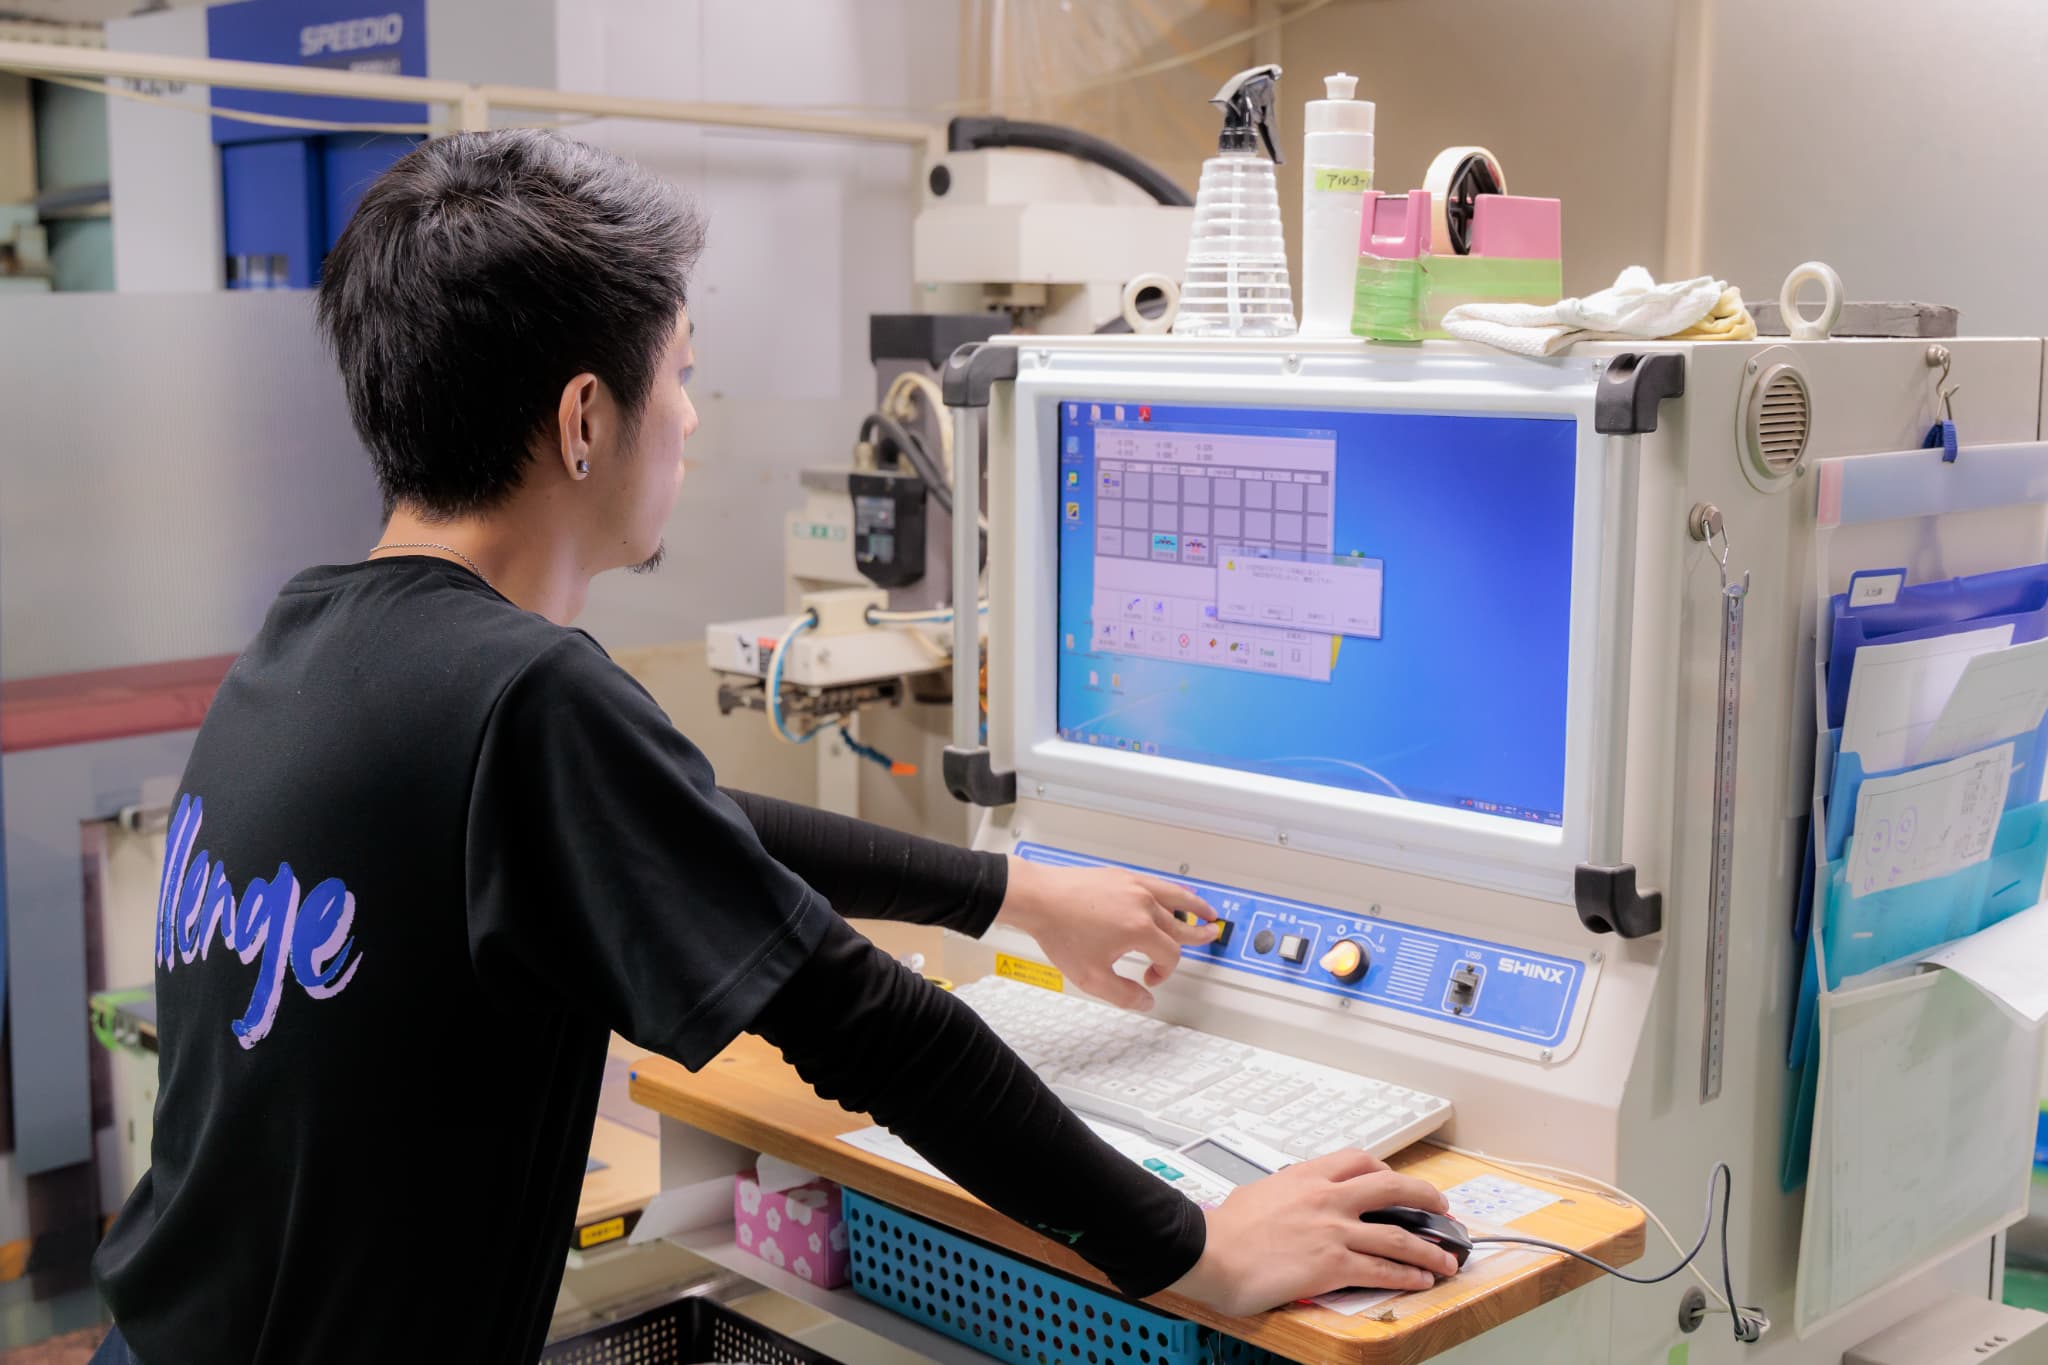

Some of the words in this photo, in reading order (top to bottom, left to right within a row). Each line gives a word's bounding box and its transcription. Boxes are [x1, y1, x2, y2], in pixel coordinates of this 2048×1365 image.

[300, 13, 403, 56] SPEEDIO
[1465, 951, 1482, 960] USB
[1498, 957, 1566, 985] SHINX
